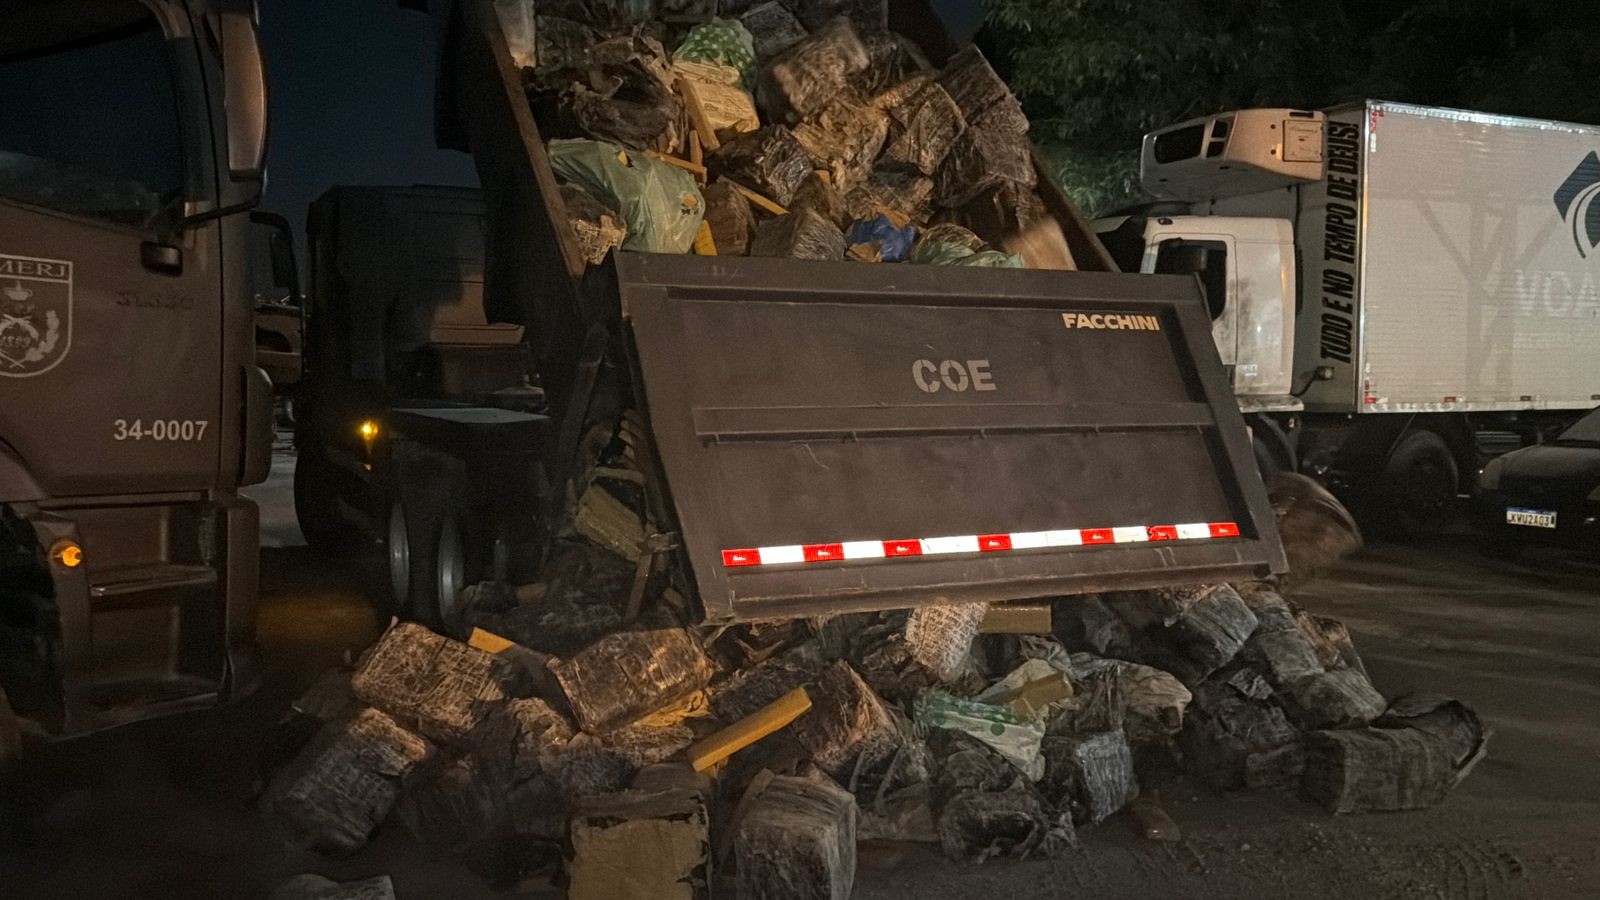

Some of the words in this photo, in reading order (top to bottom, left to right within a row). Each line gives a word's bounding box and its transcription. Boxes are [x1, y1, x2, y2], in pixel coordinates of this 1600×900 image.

[1328, 121, 1360, 175] DEUS!
[1326, 176, 1358, 202] DE
[1324, 203, 1358, 264] TEMPO
[1322, 269, 1354, 299] NO
[1062, 313, 1160, 332] FACCHINI
[1320, 313, 1353, 364] TUDO
[911, 358, 997, 394] COE
[113, 419, 208, 441] 34-0007
